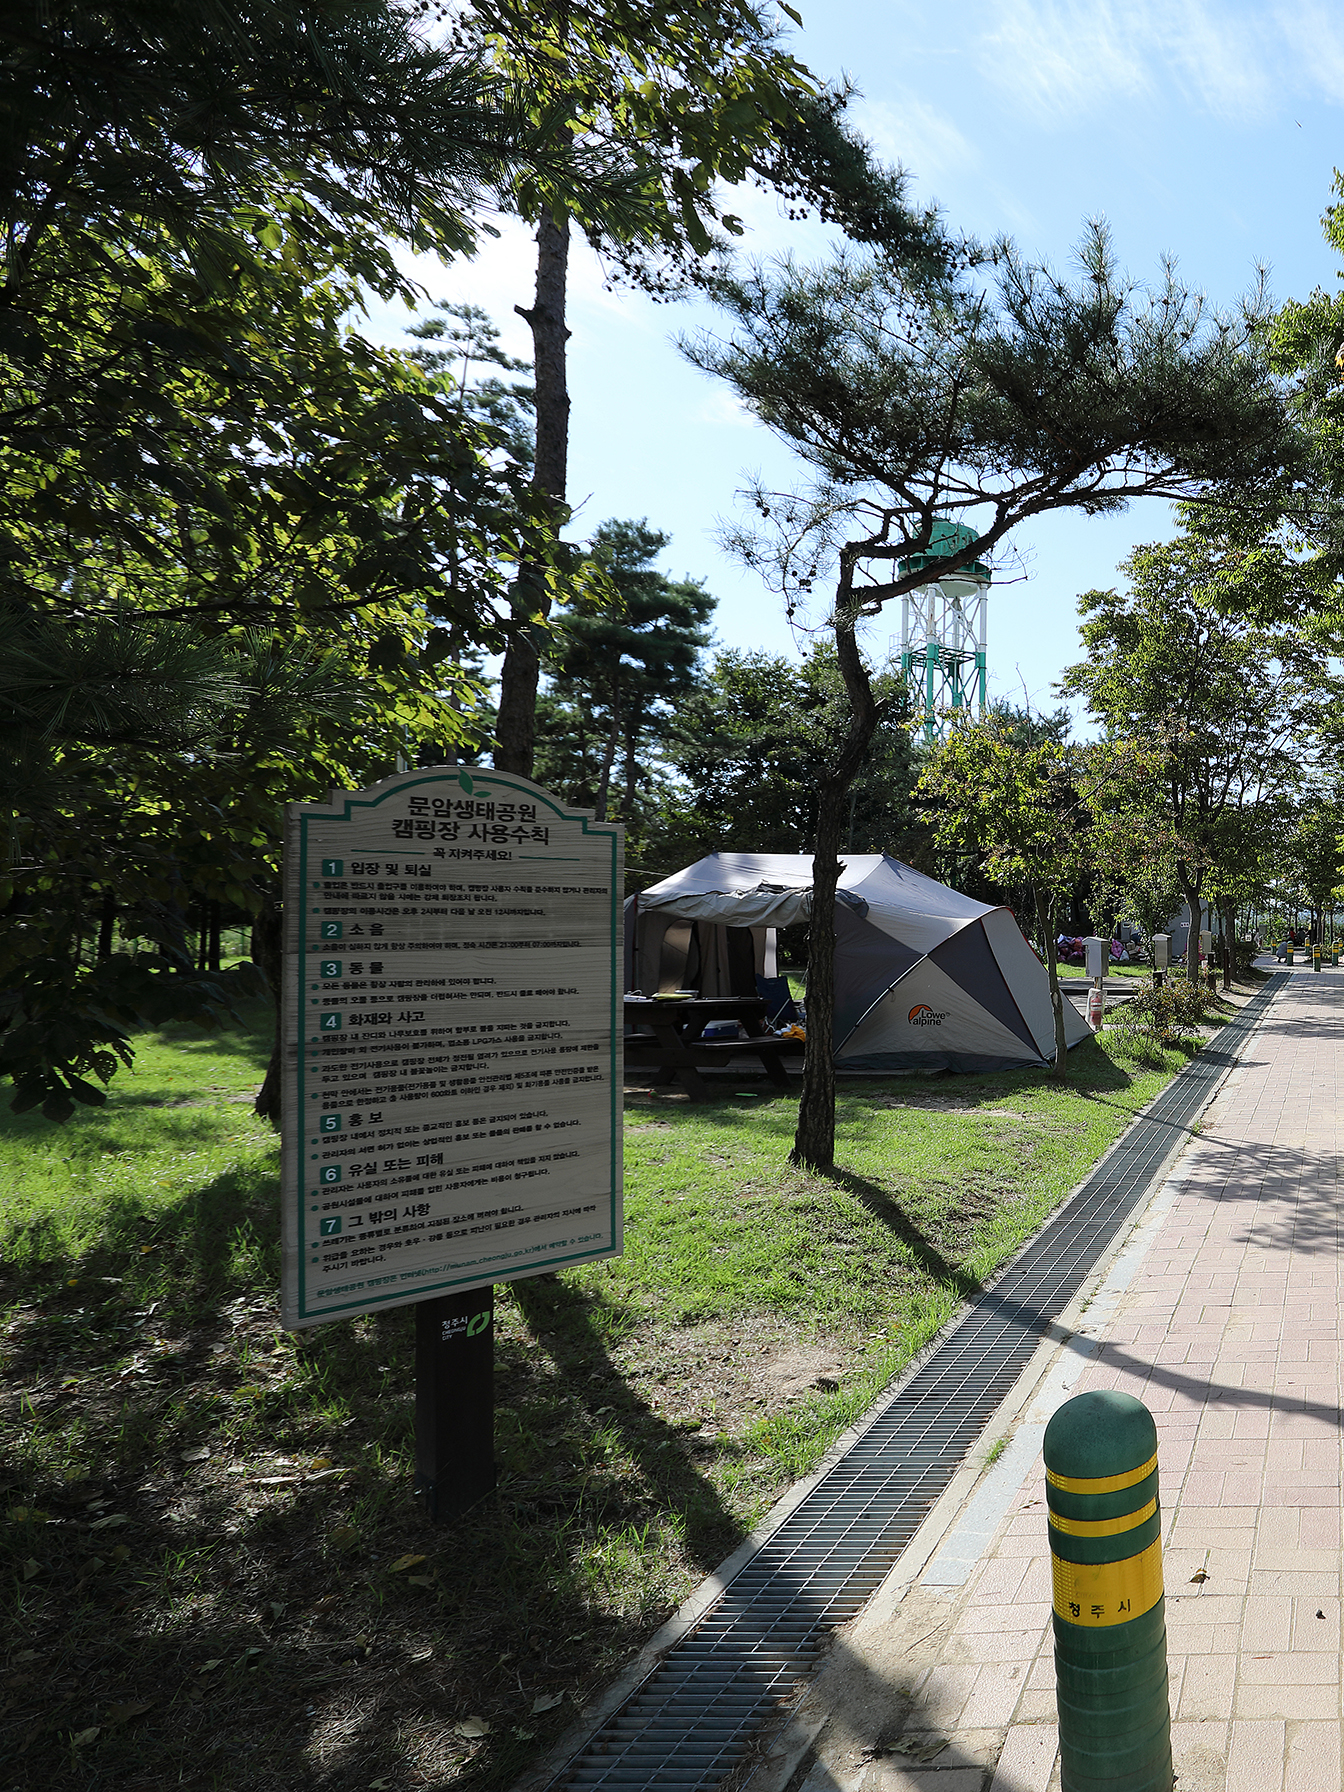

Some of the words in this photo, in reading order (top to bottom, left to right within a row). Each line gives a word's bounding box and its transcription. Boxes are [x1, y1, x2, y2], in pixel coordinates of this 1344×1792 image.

[408, 796, 536, 823] 문암생태공원
[392, 819, 460, 842] 캠핑장
[468, 822, 549, 846] 사용수칙
[434, 848, 446, 859] 꼭
[448, 849, 512, 861] 지켜주세요!
[328, 863, 336, 874] 1
[352, 862, 380, 875] 입장
[386, 864, 398, 876] 및
[404, 864, 432, 876] 퇴실
[351, 882, 374, 890] 반드시
[327, 924, 337, 936] 2
[326, 963, 337, 976] 3
[415, 979, 446, 987] 관리하에
[326, 1016, 337, 1028] 4
[349, 1012, 392, 1026] 화재와
[397, 1011, 425, 1024] 사고
[913, 1017, 941, 1027] alpine
[922, 1010, 946, 1019] Lowe
[362, 1032, 386, 1040] 잔디와
[389, 1029, 427, 1038] 나무보호를
[431, 1028, 452, 1036] 위하여
[536, 1020, 570, 1028] 금지합니다.
[322, 1047, 355, 1056] 개인장비
[370, 1043, 410, 1052] 전기사용이
[528, 1033, 563, 1041] 금지합니다.
[322, 1064, 347, 1072] 과도한
[351, 1060, 398, 1070] 전기사용으로
[477, 1052, 498, 1060] 염려가
[501, 1050, 528, 1058] 있으므로
[322, 1075, 339, 1083] 두고
[451, 1062, 489, 1072] 금지합니다.
[341, 1088, 372, 1097] 안에서는
[478, 1074, 512, 1084] 안전관리법
[356, 1097, 387, 1106] 한정하고
[431, 1089, 457, 1098] 600와트
[460, 1087, 480, 1095] 이하인
[572, 1075, 604, 1083] 금지합니다.
[326, 1117, 336, 1130] 5
[350, 1131, 374, 1140] 내에서
[378, 1128, 402, 1137] 정치적
[422, 1121, 452, 1131] 종교적인
[489, 1114, 516, 1123] 금지되어
[519, 1110, 548, 1120] 있습니다.
[322, 1149, 355, 1159] 관리자의
[396, 1140, 420, 1149] 없이는
[422, 1135, 452, 1145] 상업적인
[455, 1134, 470, 1142] 홍보
[553, 1120, 581, 1129] 없습니다.
[322, 1185, 354, 1196] 관리자는
[357, 1179, 388, 1189] 사용자의
[422, 1171, 437, 1179] 대한
[439, 1169, 453, 1177] 유실
[495, 1160, 514, 1168] 대하여
[326, 1168, 336, 1181] 6
[348, 1161, 377, 1177] 유실
[383, 1158, 411, 1172] 또는
[416, 1153, 443, 1167] 피해
[322, 1196, 372, 1211] 공원시설물에
[375, 1192, 399, 1202] 대하여
[445, 1178, 488, 1191] 사용자에게는
[491, 1174, 512, 1183] 비용이
[514, 1169, 550, 1180] 청구됩니다.
[322, 1235, 356, 1247] 쓰레기는
[394, 1223, 425, 1234] 분류하여
[452, 1214, 475, 1223] 장소에
[477, 1211, 498, 1219] 버려야
[501, 1205, 524, 1214] 합니다.
[326, 1220, 336, 1232] 7
[348, 1216, 364, 1227] 그
[369, 1208, 397, 1224] 밖의
[403, 1203, 430, 1217] 사항
[350, 1246, 375, 1257] 요하는
[379, 1241, 402, 1252] 경우와
[518, 1216, 531, 1225] 경우
[533, 1212, 560, 1222] 관리자의
[562, 1208, 581, 1217] 지시에
[583, 1205, 596, 1213] 따라
[317, 1281, 364, 1298] 문암생태공원
[578, 1233, 603, 1244] 있습니다.
[322, 1261, 347, 1273] 주시기
[351, 1255, 386, 1267] 바랍니다.
